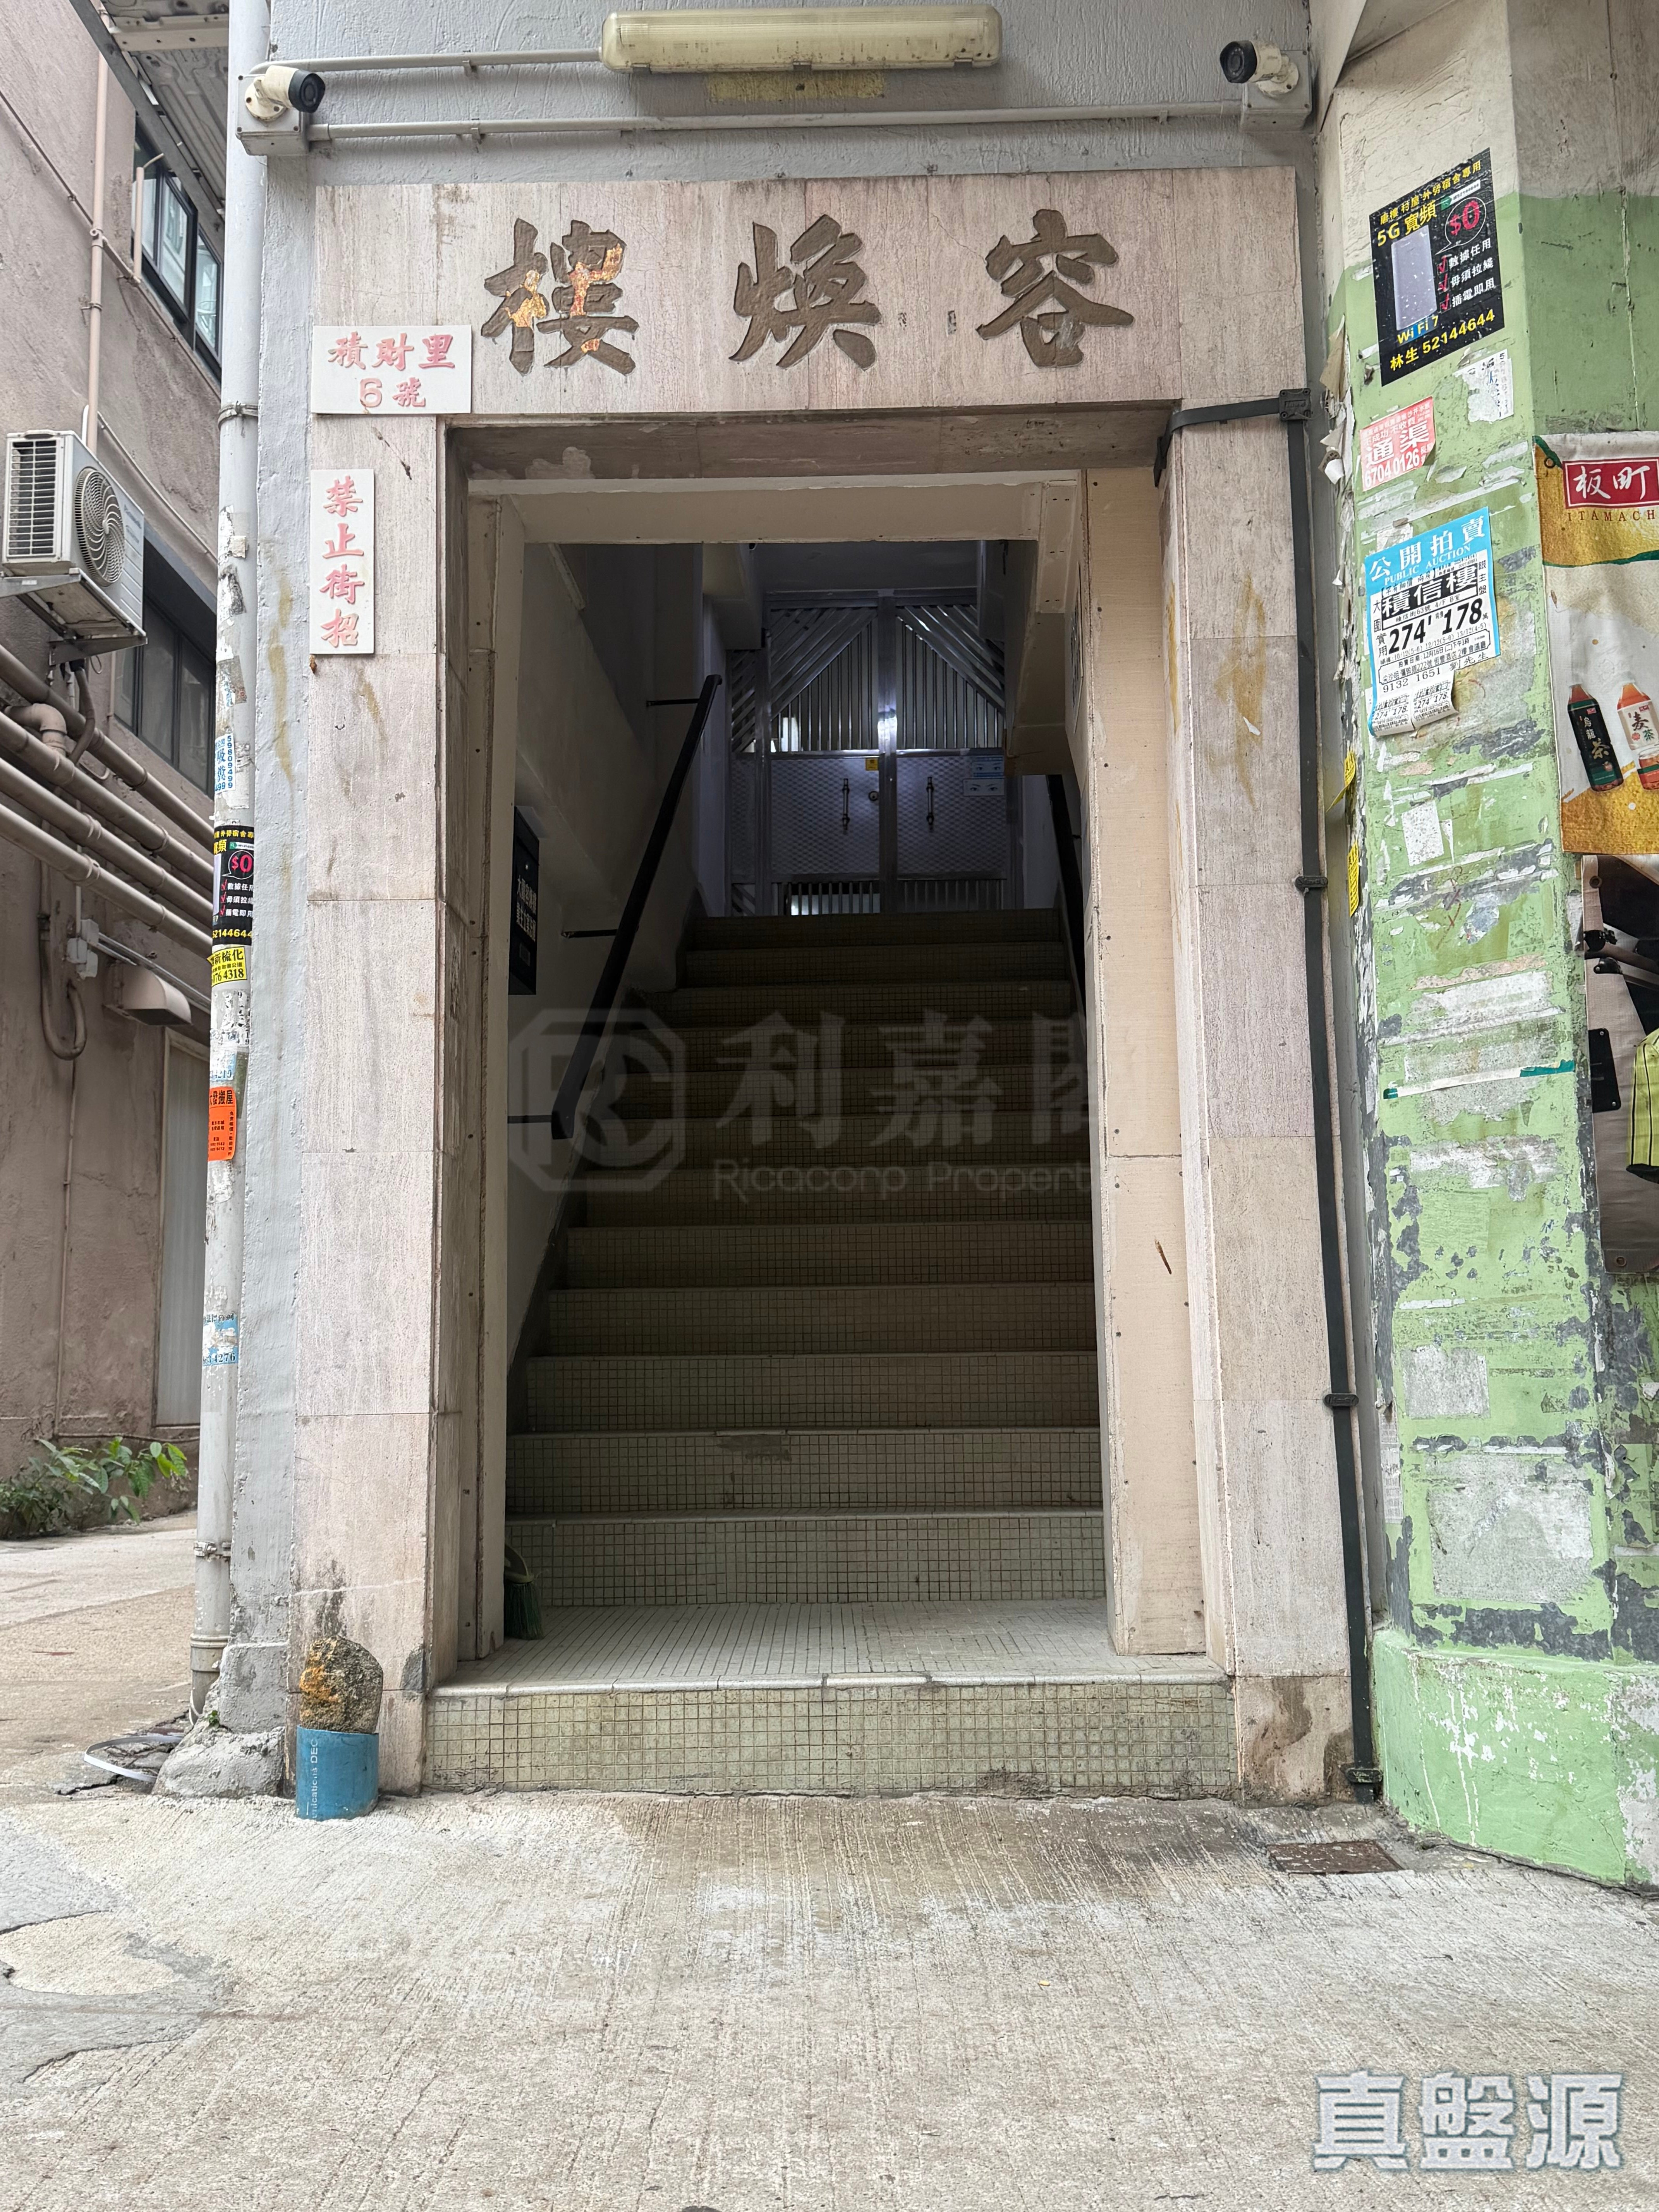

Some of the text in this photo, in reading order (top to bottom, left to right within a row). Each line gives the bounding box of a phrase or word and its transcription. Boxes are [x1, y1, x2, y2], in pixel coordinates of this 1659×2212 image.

[1377, 200, 1437, 247] 5G 寬頻
[1449, 200, 1480, 235] $0
[1449, 238, 1491, 269] 數據任用
[1452, 278, 1494, 307] 插電即用
[1432, 316, 1439, 327] 7
[328, 331, 455, 371] 積財里
[1390, 309, 1495, 371] 林生 52144644
[1365, 420, 1429, 468] 通渠
[1365, 461, 1391, 488] 6704
[1393, 448, 1420, 474] 0126
[1573, 465, 1650, 500] 板町
[1568, 509, 1655, 521] ITAMACH
[319, 475, 365, 648] 禁止街招
[1369, 515, 1485, 581] 公開拍賣
[1384, 565, 1419, 586] PUBLIC
[1426, 544, 1470, 569] AUCTION
[1382, 567, 1477, 617] 積信樓
[1479, 560, 1487, 595] 銀主盤
[1435, 598, 1446, 609] 4/F
[1442, 598, 1482, 635] 178
[1376, 633, 1388, 658] 實用
[1383, 678, 1408, 693] 9132
[1416, 667, 1441, 682] 1651
[231, 854, 252, 874] $0
[223, 968, 244, 979] 4318
